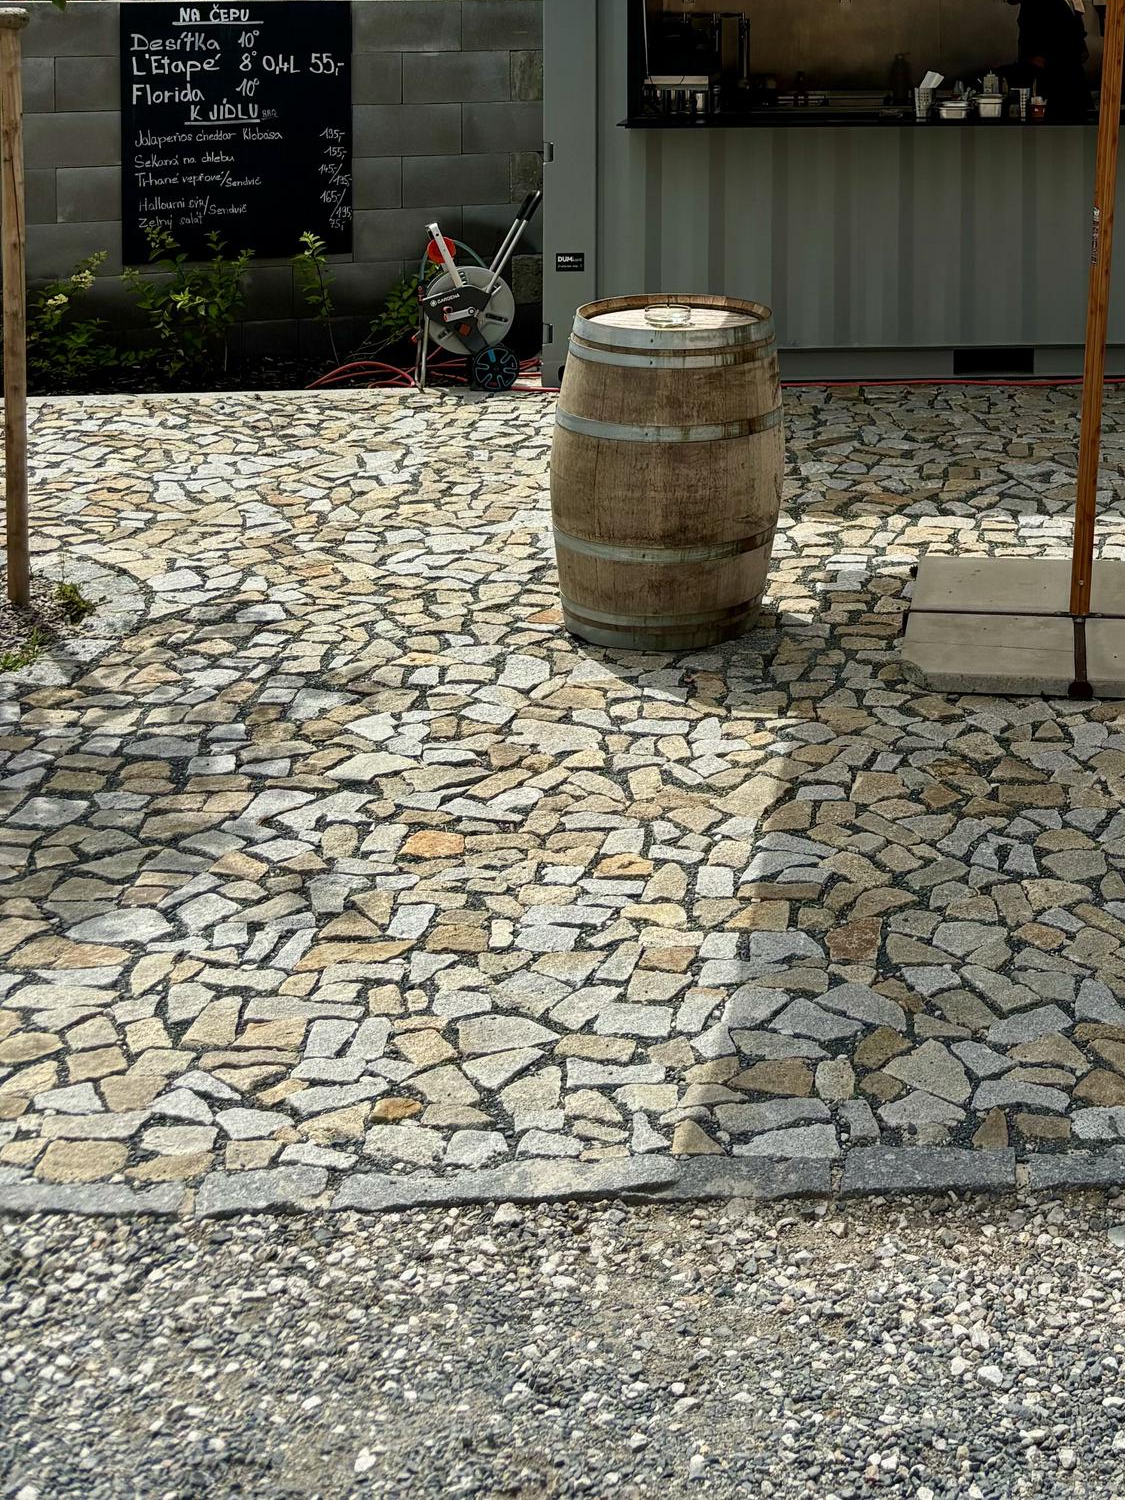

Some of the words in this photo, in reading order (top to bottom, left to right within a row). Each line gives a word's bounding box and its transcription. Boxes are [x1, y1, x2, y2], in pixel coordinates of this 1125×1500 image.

[179, 7, 200, 22] NA
[209, 4, 250, 22] ČEPU
[262, 54, 300, 75] 0,4L
[309, 53, 345, 76] 55,-
[132, 83, 205, 105] Florida
[190, 105, 203, 121] K
[209, 98, 259, 120] JÍDLU
[183, 157, 196, 165] na
[201, 151, 235, 164] chlebu
[134, 171, 179, 187] Trhané
[139, 197, 186, 212] Halloumi
